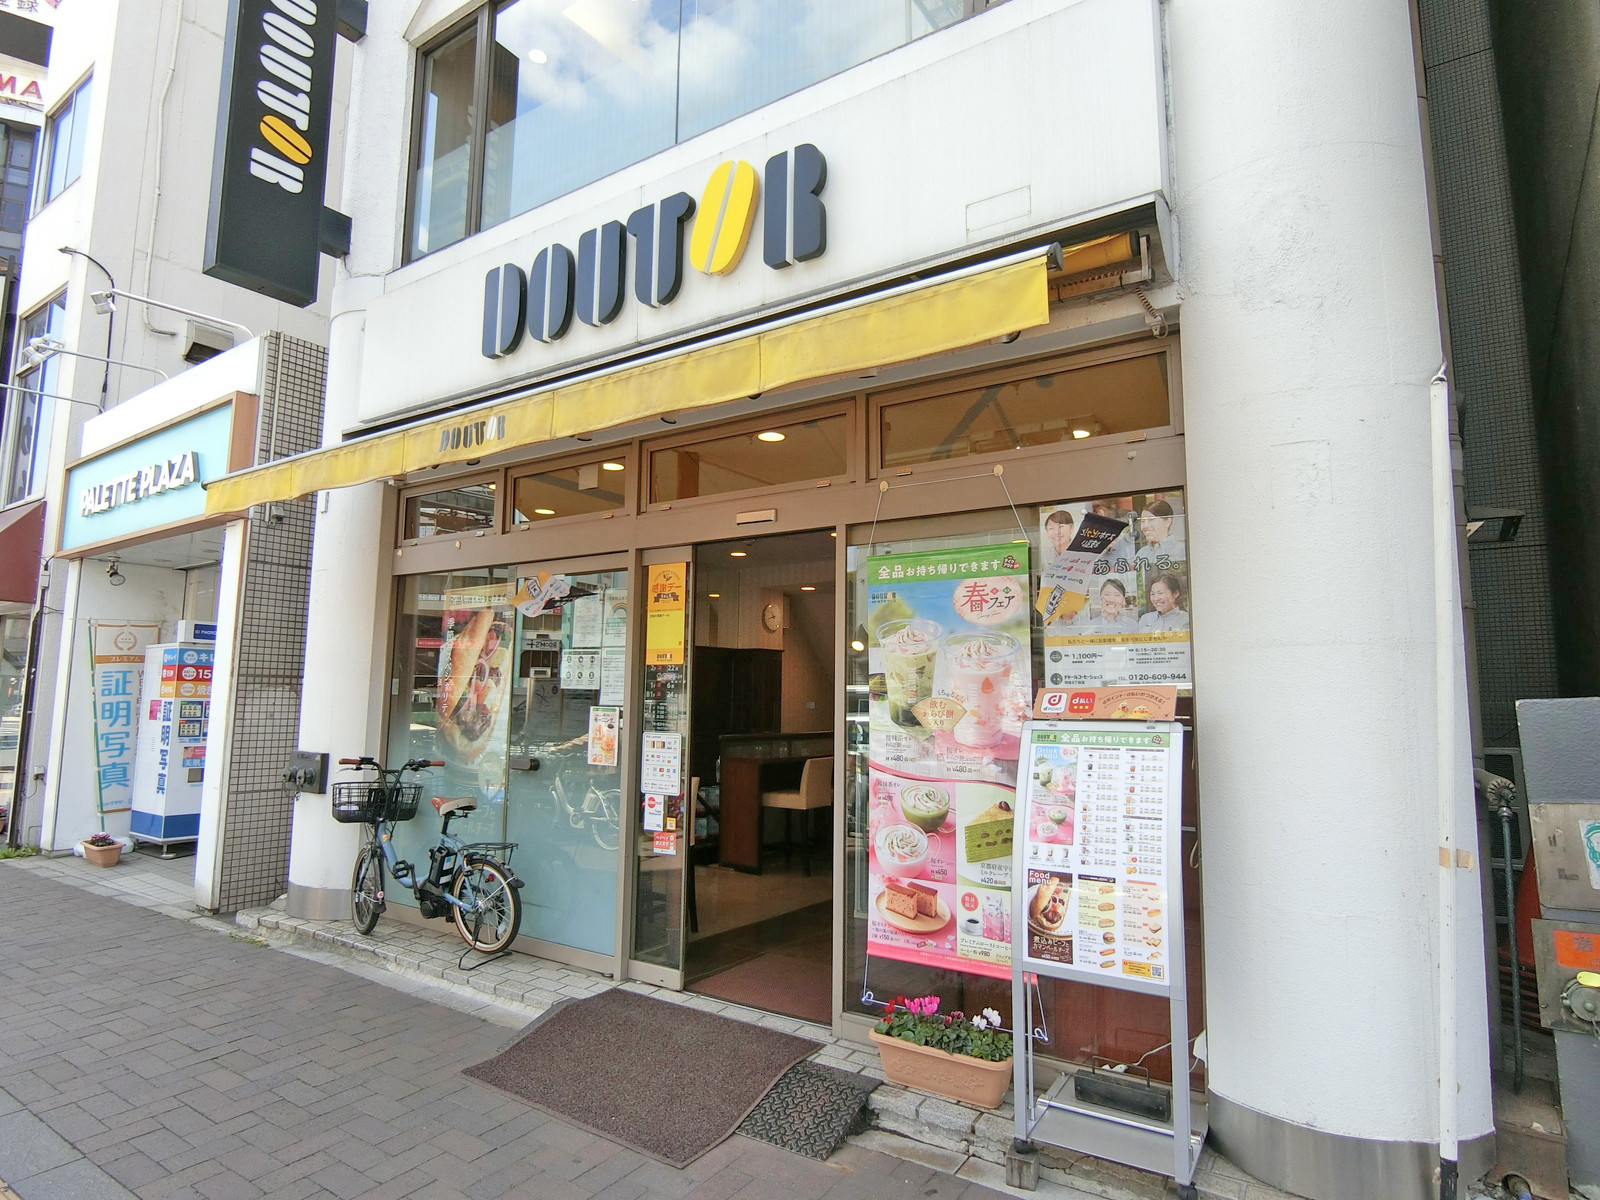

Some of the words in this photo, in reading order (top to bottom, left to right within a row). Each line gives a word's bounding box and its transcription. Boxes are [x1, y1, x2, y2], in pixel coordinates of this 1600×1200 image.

[481, 143, 828, 360] DOUTOR
[438, 415, 506, 453] DOUTOR
[80, 469, 143, 518] PALETTE
[139, 450, 200, 500] PLAZA
[878, 559, 1001, 579] 全品お持ち帰りできます
[1093, 554, 1181, 576] あふれる。
[960, 581, 990, 613] 春
[987, 595, 1016, 610] フェア
[1128, 673, 1187, 681] 0120-609-944
[929, 700, 947, 709] 飲む
[1072, 696, 1093, 704] d払い
[922, 709, 954, 719] わらび餅
[100, 670, 134, 790] 証明写真
[933, 719, 944, 727] 入り
[1060, 732, 1151, 745] 全品お持ち帰りできます
[157, 701, 173, 795] 証明写真
[1029, 870, 1050, 879] Food
[1029, 877, 1052, 885] menu
